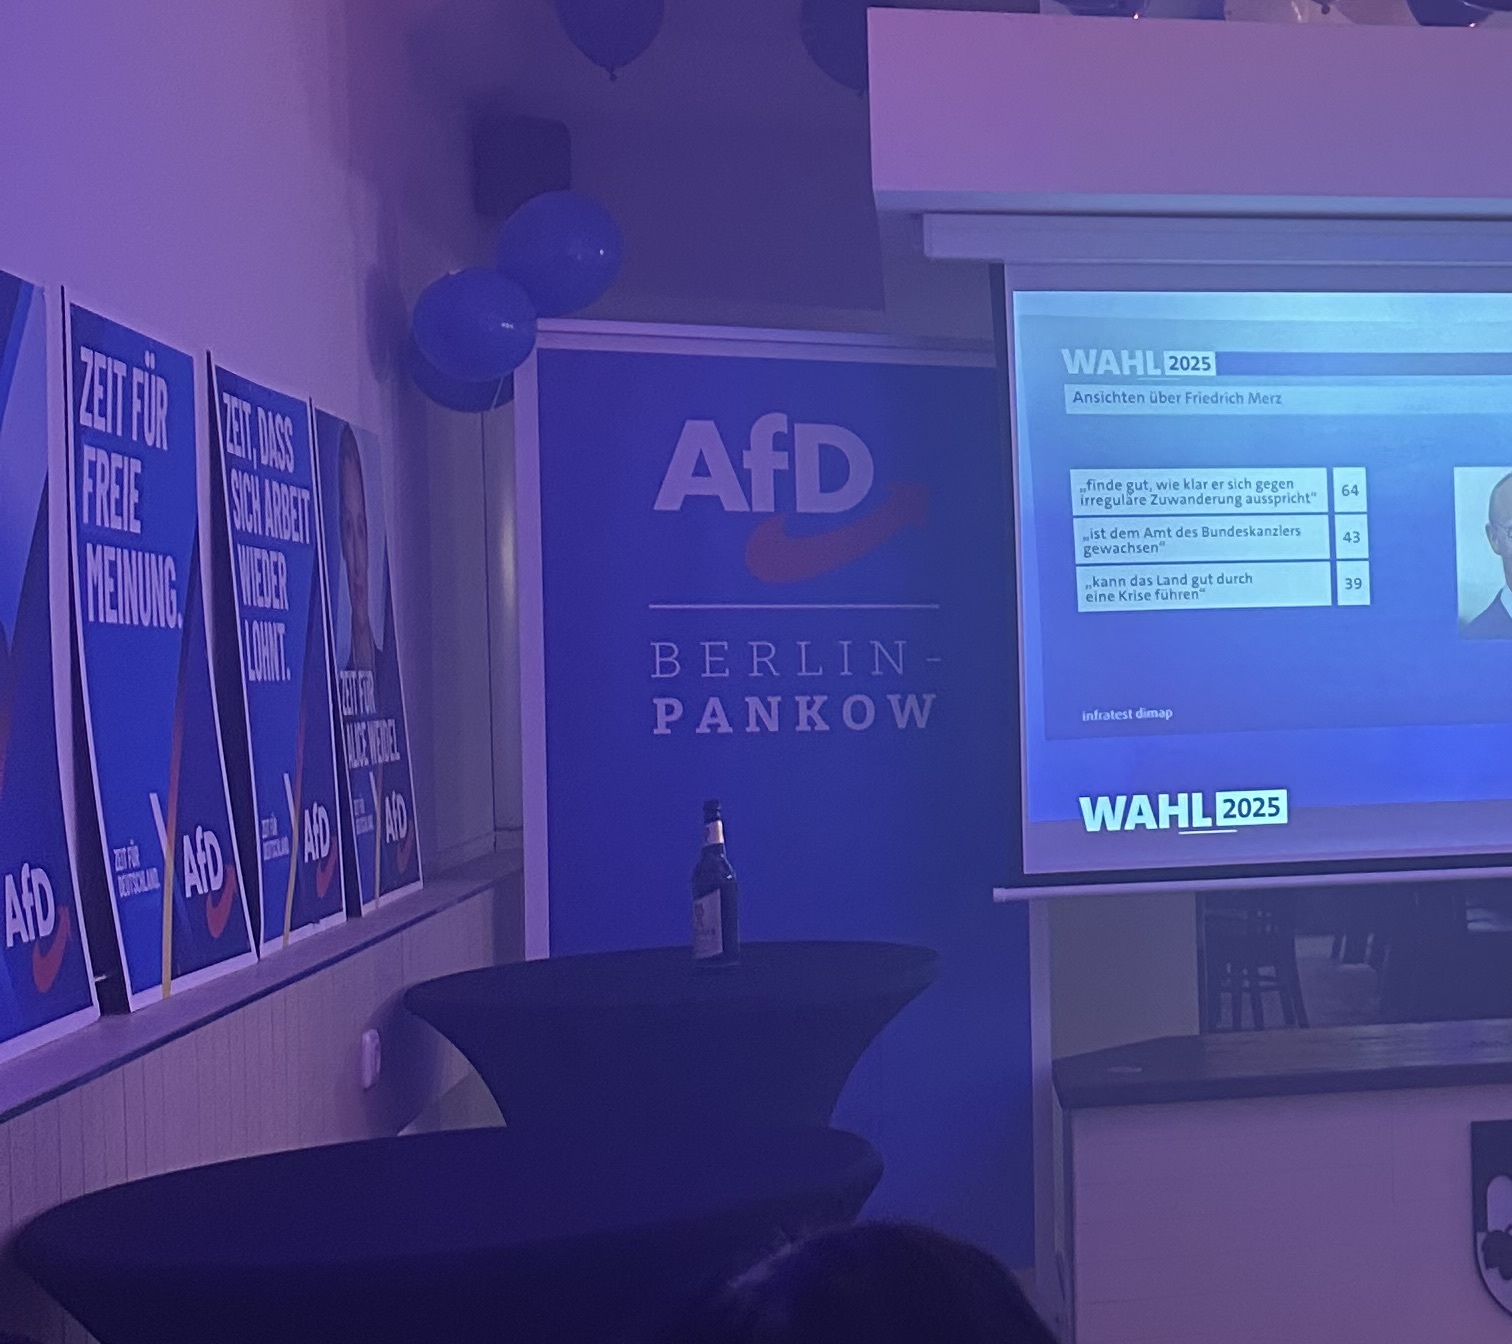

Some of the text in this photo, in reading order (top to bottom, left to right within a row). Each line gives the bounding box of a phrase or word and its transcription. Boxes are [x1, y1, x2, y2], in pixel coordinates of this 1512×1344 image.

[1061, 348, 1212, 376] WAHL 2025
[79, 346, 169, 452] ZEIT FÜR
[1072, 390, 1282, 405] Ansichten über Friedrich Merz
[222, 391, 295, 474] ZEIT, DASS
[653, 412, 875, 514] AfD
[82, 444, 142, 535] FREIE
[230, 468, 311, 545] SICH ARBEIT
[1080, 492, 1147, 510] irreguläre
[1150, 492, 1243, 509] Zuwanderung
[1126, 479, 1153, 499] gut,
[1156, 478, 1180, 492] wie
[1183, 477, 1208, 491] klar
[1211, 479, 1224, 491] er
[1227, 477, 1252, 491] sich
[1255, 478, 1295, 495] gegen
[1341, 483, 1360, 497] 64
[1110, 526, 1140, 540] dem
[1143, 526, 1173, 540] Amt
[1175, 525, 1198, 539] des
[1201, 524, 1302, 538] Bundeskanzlers
[1342, 531, 1361, 544] 43
[85, 542, 183, 630] MEINUNG.
[236, 544, 289, 611] WIEDER
[1085, 589, 1115, 603] eine
[1118, 588, 1151, 602] Krise
[1130, 574, 1153, 588] das
[1156, 573, 1188, 587] Land
[1191, 574, 1213, 589] gut
[1216, 572, 1253, 585] durch
[1344, 577, 1363, 590] 39
[244, 619, 292, 683] LOHNT.
[650, 640, 942, 679] BERLIN-
[652, 693, 937, 735] PANKOW
[1082, 707, 1174, 722] infratest dimap
[303, 801, 331, 864] AfD
[384, 790, 408, 844] AfD
[1079, 792, 1281, 832] WAHL 2025
[182, 825, 224, 898] AfD
[4, 862, 56, 948] AfD
